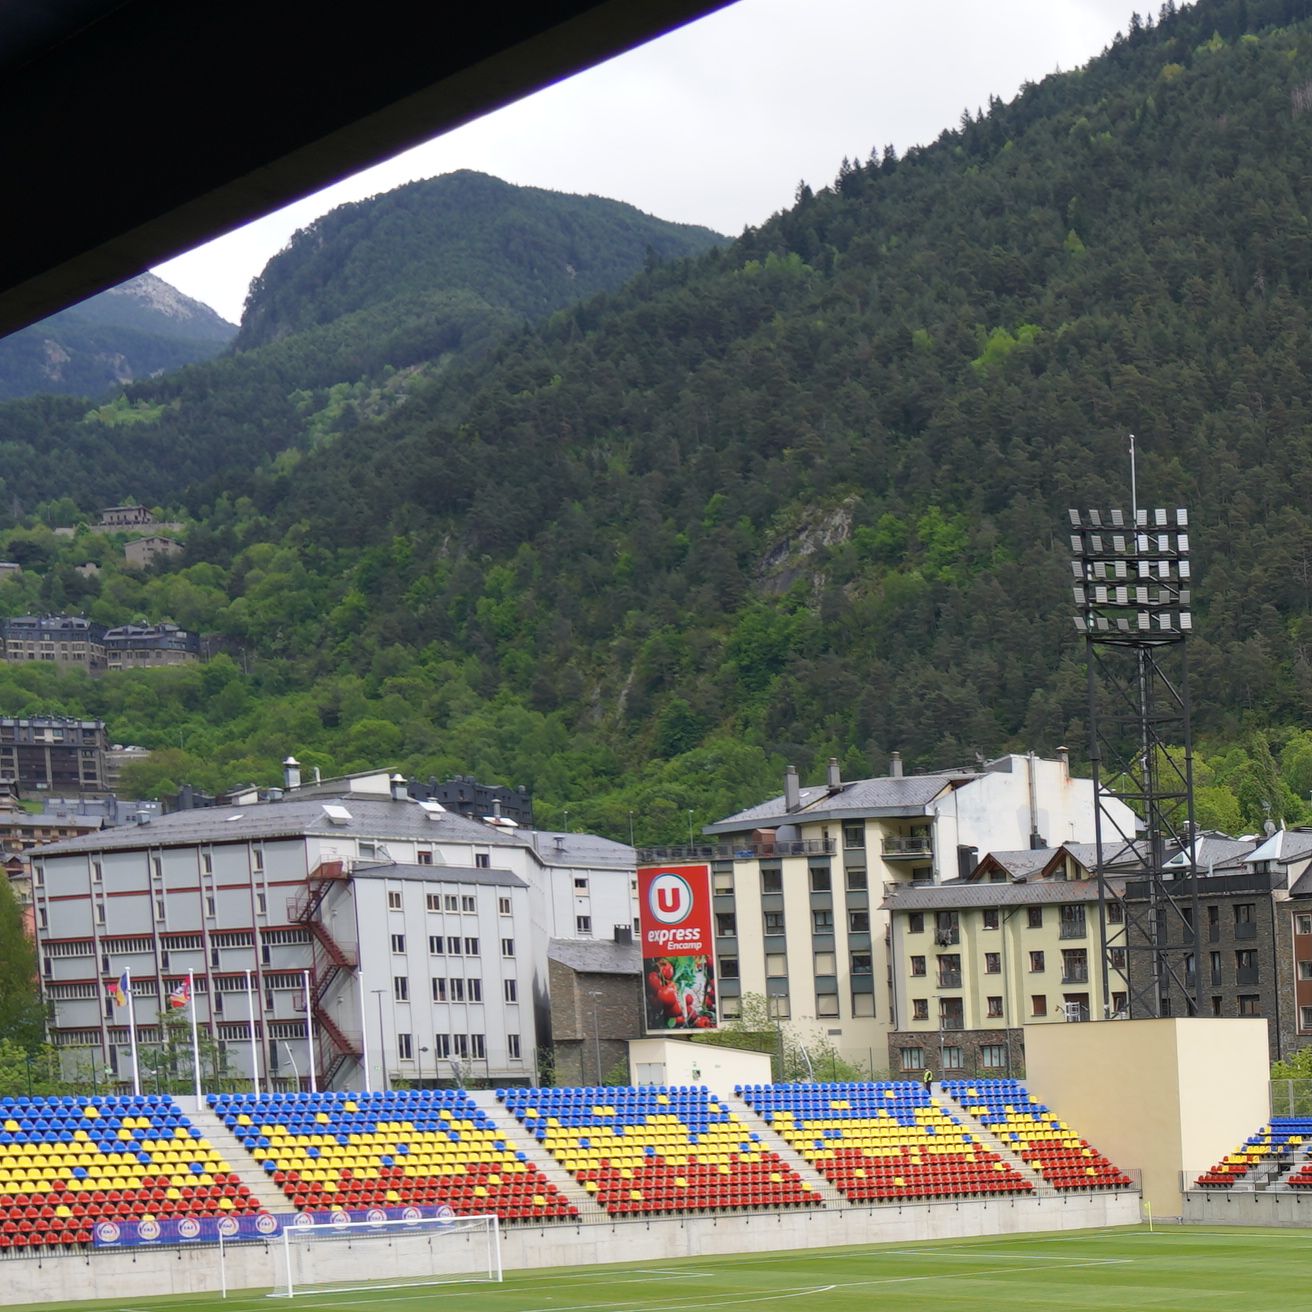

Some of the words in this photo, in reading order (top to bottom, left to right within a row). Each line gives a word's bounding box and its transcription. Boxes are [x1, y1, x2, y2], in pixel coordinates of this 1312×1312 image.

[657, 888, 680, 912] U
[648, 928, 701, 945] express
[667, 941, 702, 950] Encamp
